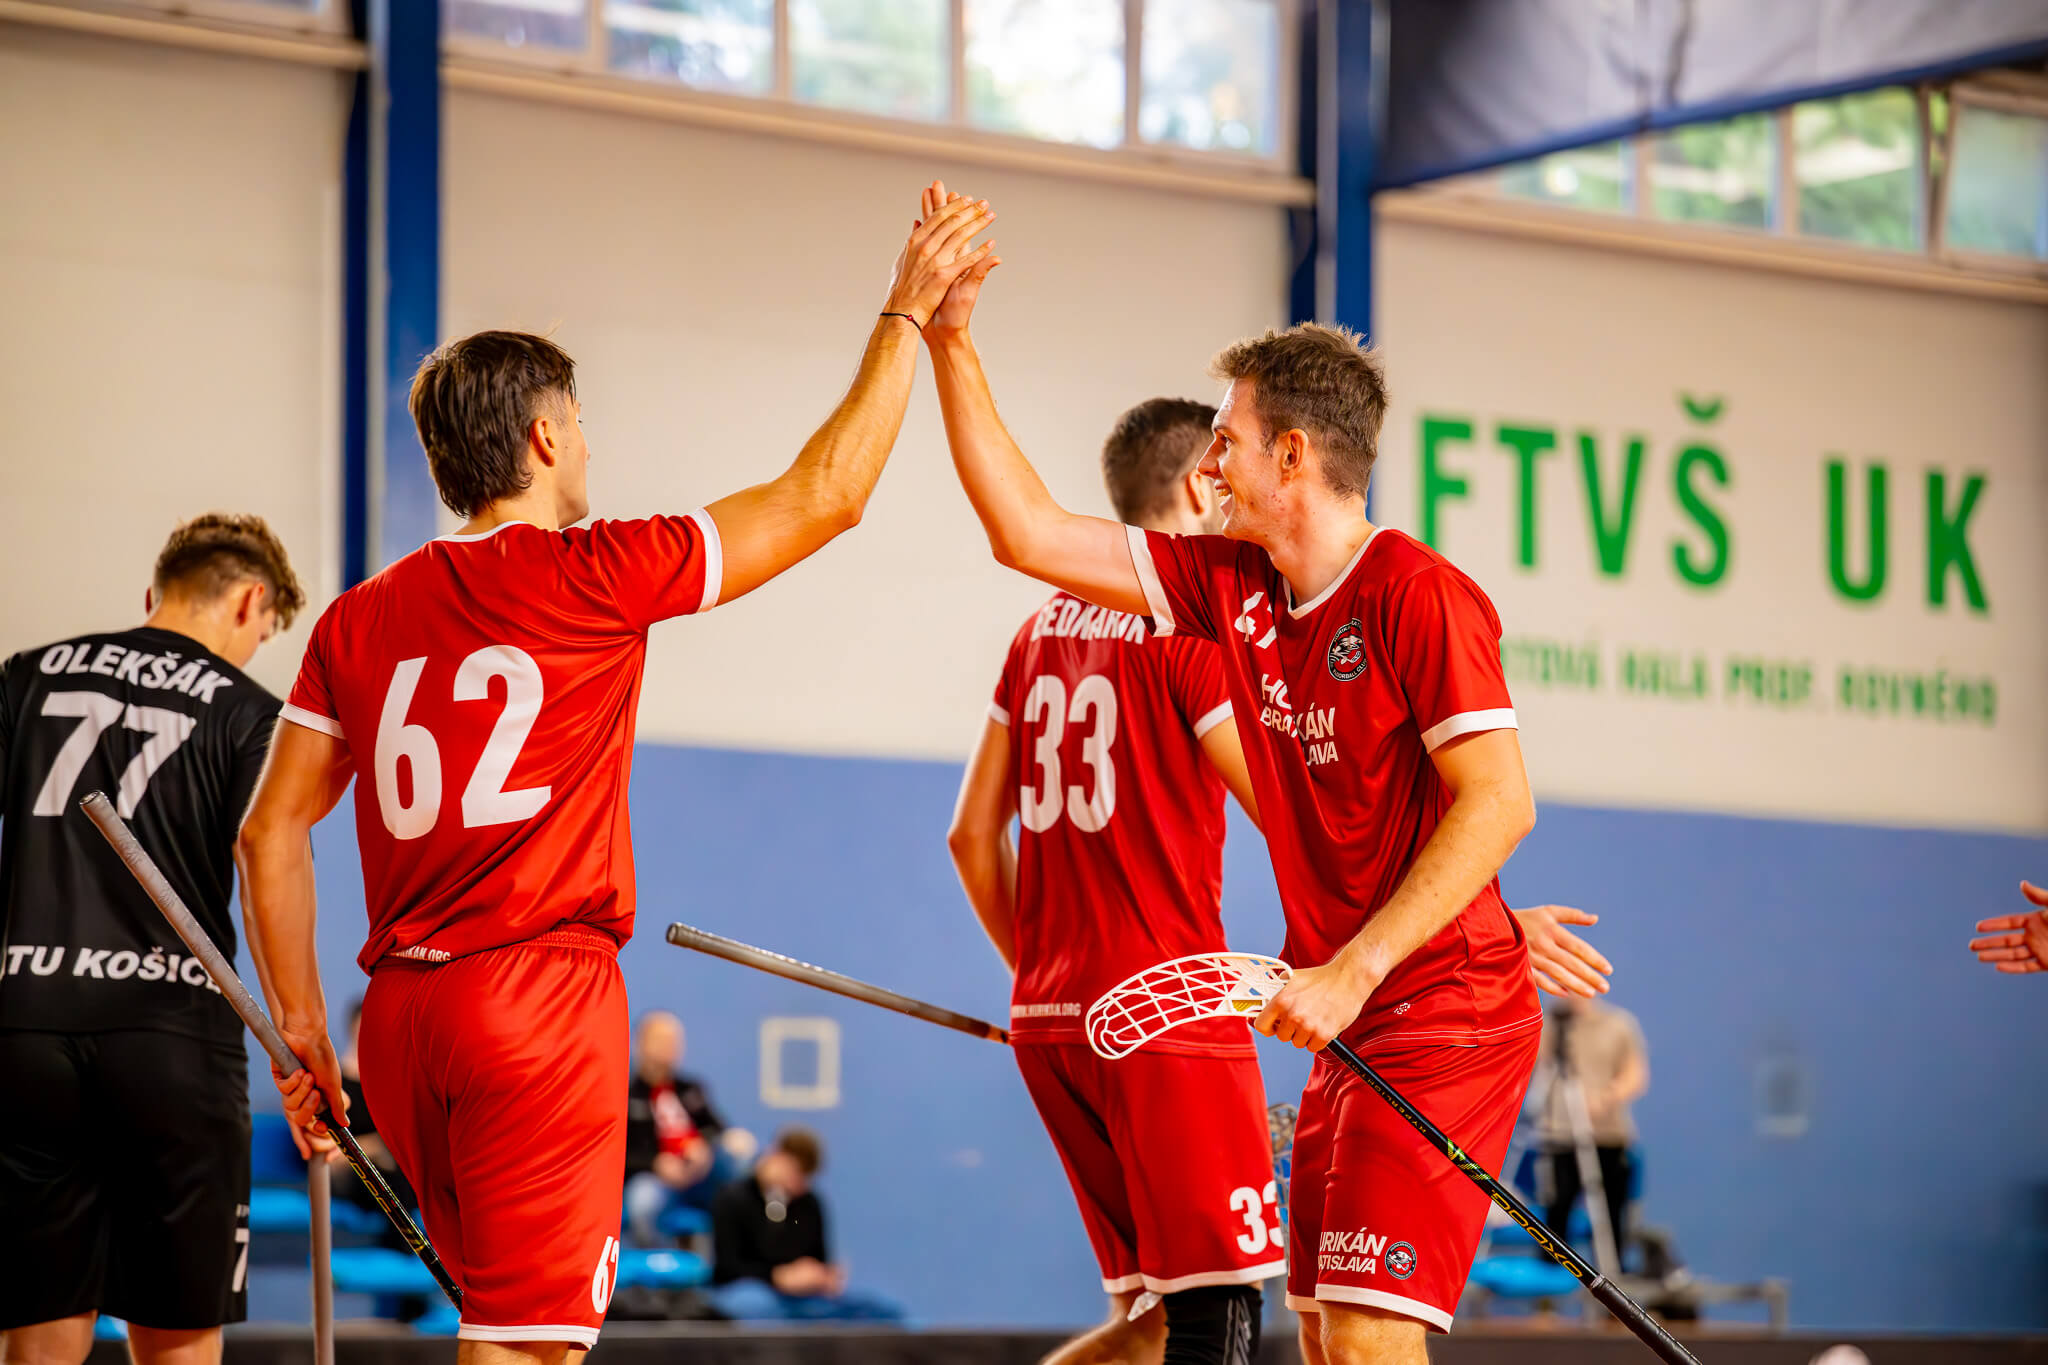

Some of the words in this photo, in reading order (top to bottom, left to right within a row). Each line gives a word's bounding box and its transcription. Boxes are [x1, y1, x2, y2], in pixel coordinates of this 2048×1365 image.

[1418, 391, 1731, 591] FTVŠ
[1822, 457, 1989, 614] UK
[39, 643, 233, 704] OLEKŠÁK
[374, 644, 552, 840] 62
[33, 691, 197, 820] 77
[1020, 674, 1118, 833] 33
